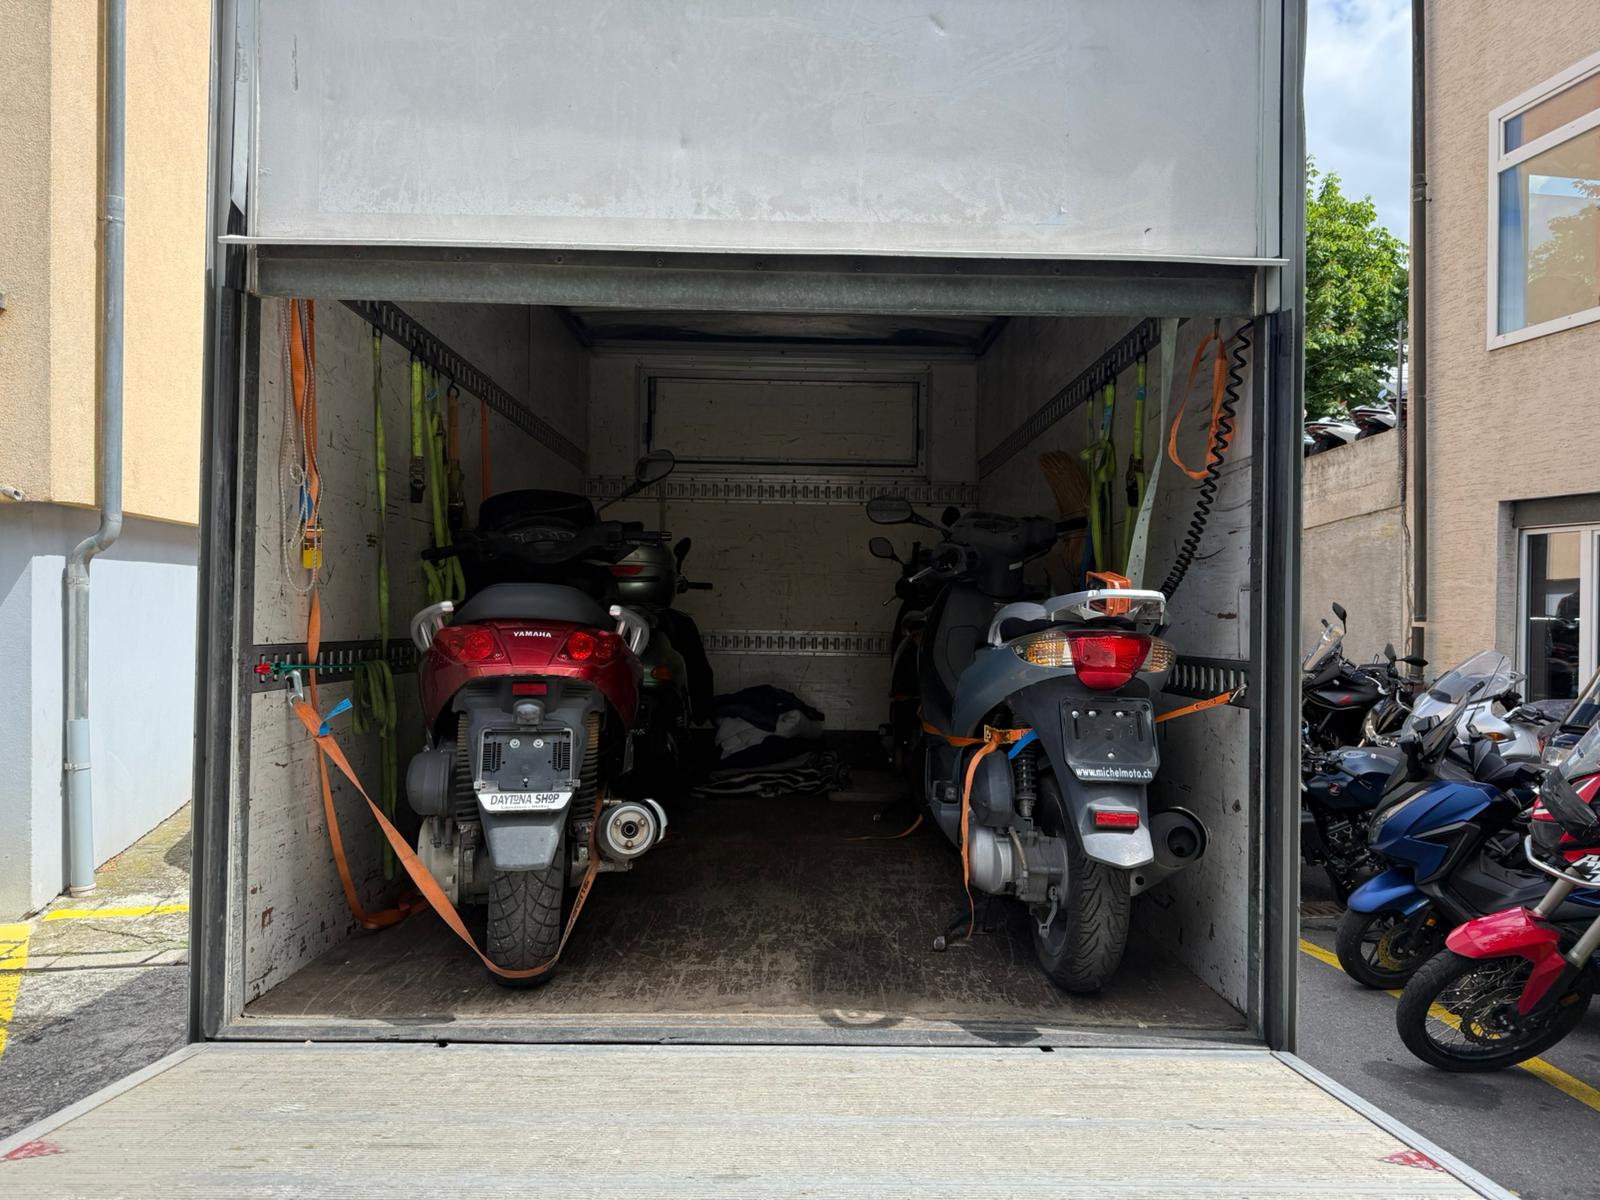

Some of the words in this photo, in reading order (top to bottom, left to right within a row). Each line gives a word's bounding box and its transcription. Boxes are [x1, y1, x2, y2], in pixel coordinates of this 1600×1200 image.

[1075, 767, 1153, 778] www.michelmoto.ch
[490, 794, 532, 805] DAYTONA
[534, 793, 560, 804] SHOP
